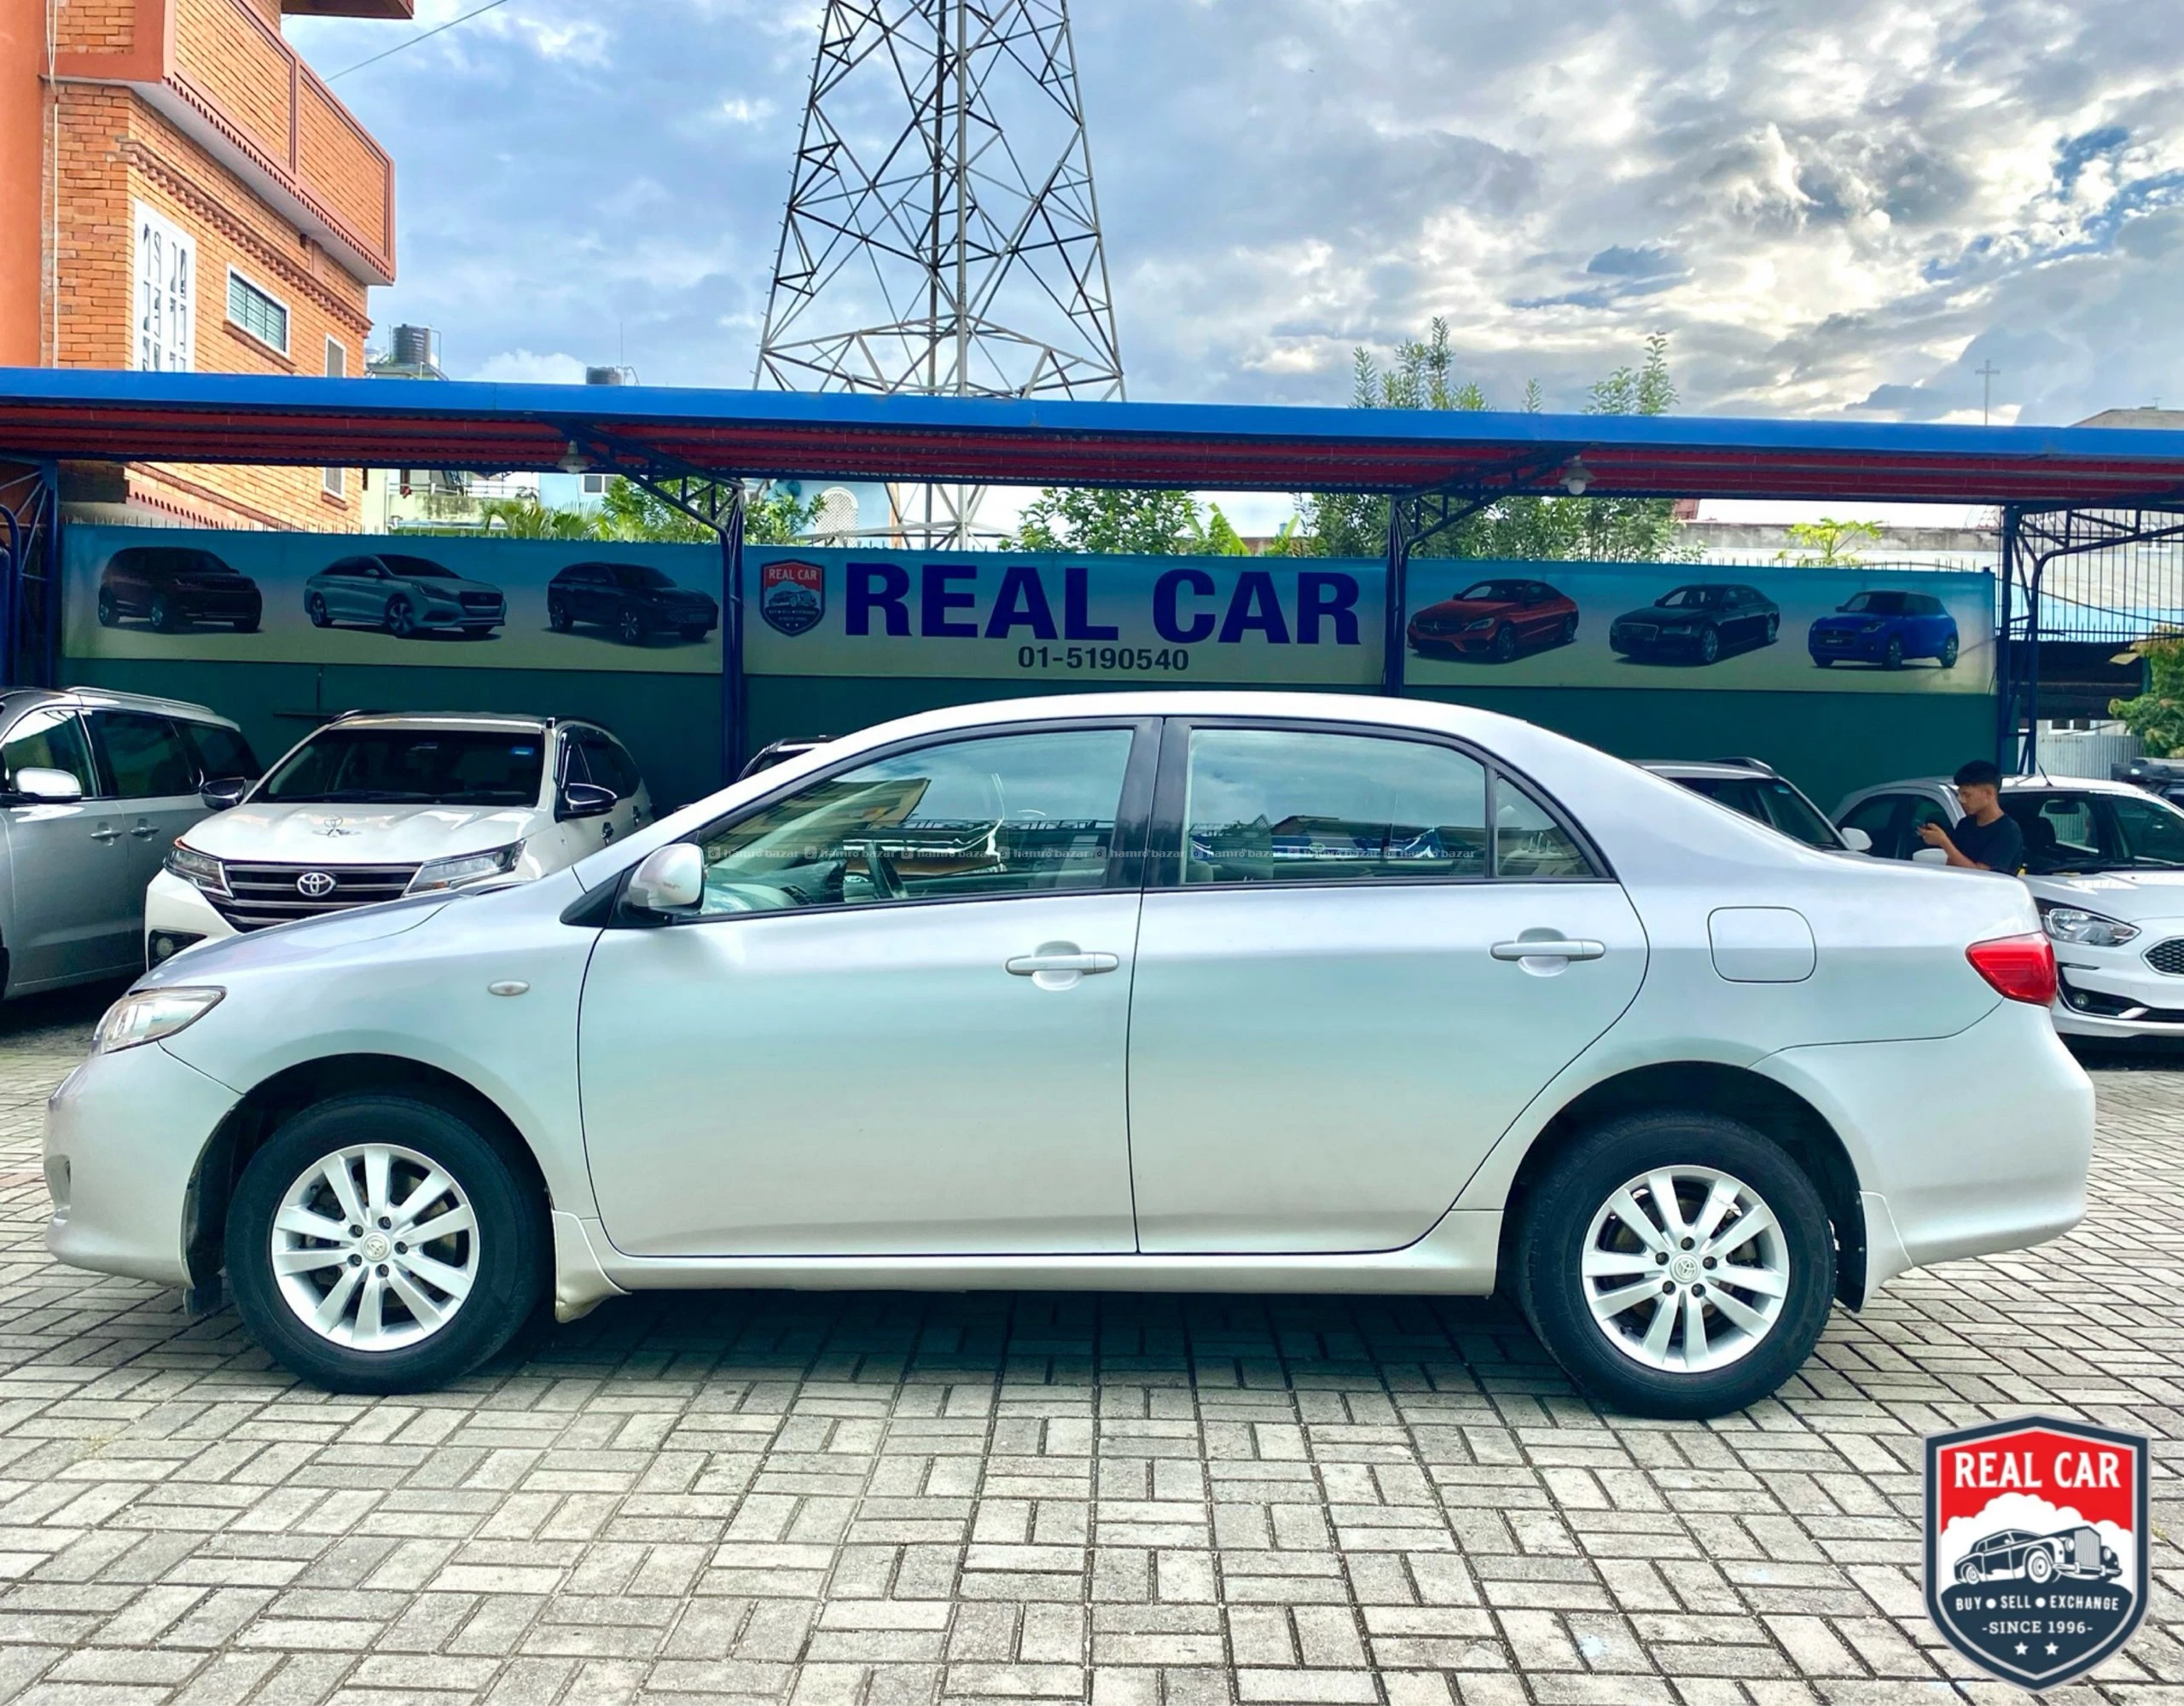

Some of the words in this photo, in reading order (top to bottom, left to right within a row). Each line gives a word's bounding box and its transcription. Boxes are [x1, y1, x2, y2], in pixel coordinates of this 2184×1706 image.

[770, 569, 795, 580] REAL
[798, 570, 817, 580] CAR
[845, 563, 1118, 641] REAL
[1153, 569, 1362, 646] CAR
[1018, 646, 1189, 671] 01-5190540
